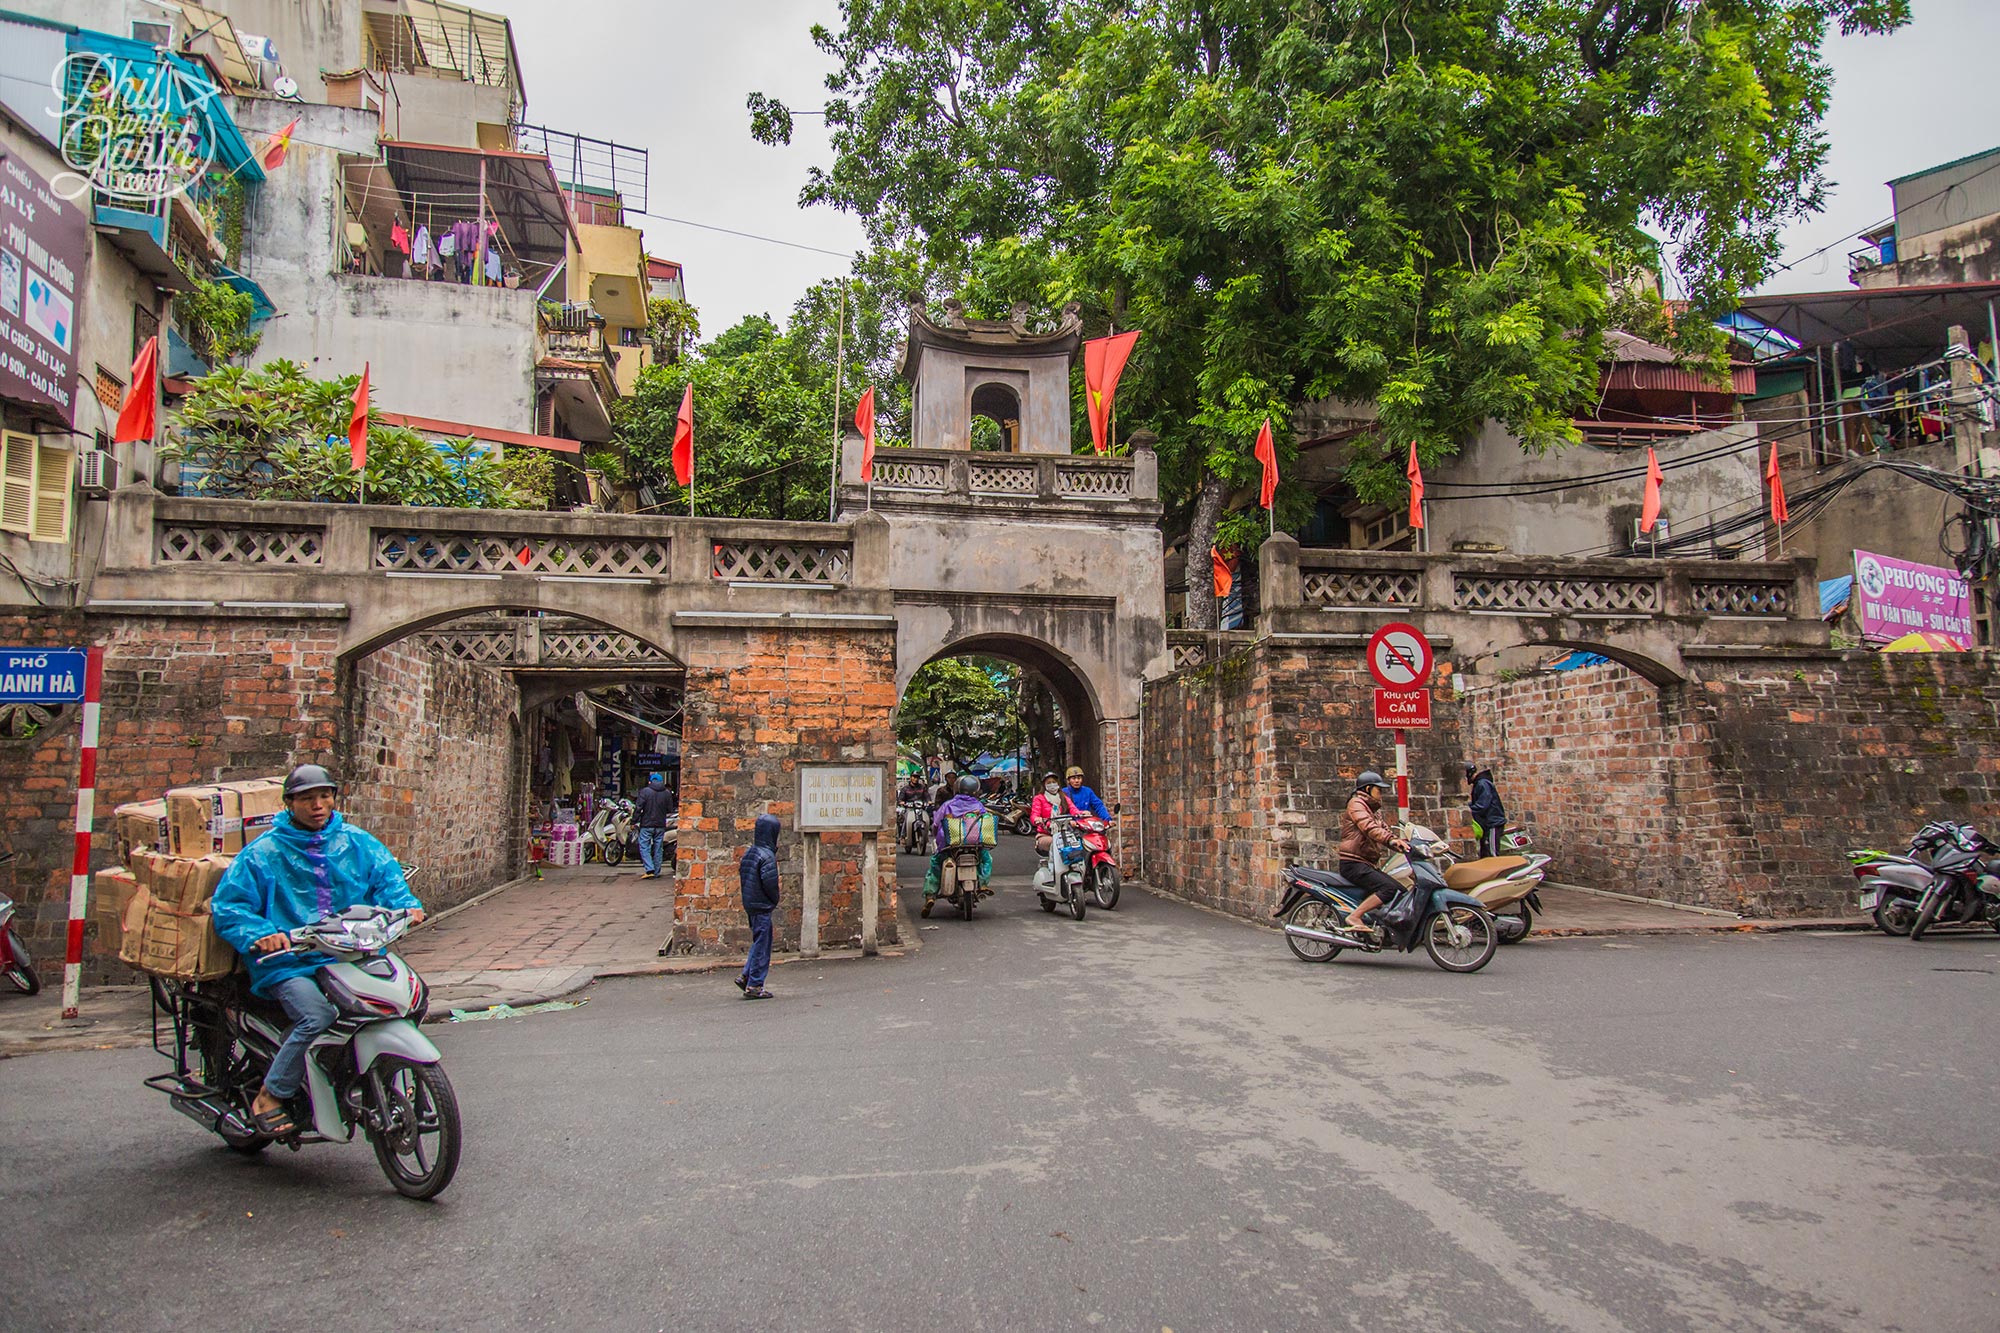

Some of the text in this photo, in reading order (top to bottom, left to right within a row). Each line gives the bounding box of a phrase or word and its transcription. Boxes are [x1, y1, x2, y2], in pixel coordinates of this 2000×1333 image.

[9, 222, 26, 255] PHÚ
[27, 237, 49, 274] MINH
[31, 371, 48, 393] CAO
[1883, 566, 1946, 595] PHƯƠNG
[9, 653, 48, 668] PHỐ
[0, 670, 76, 693] ANH HÀ
[1383, 690, 1420, 701] KHU VỰC
[1389, 701, 1417, 713] CẤM
[1377, 716, 1429, 725] BÁN HÀNG RONG
